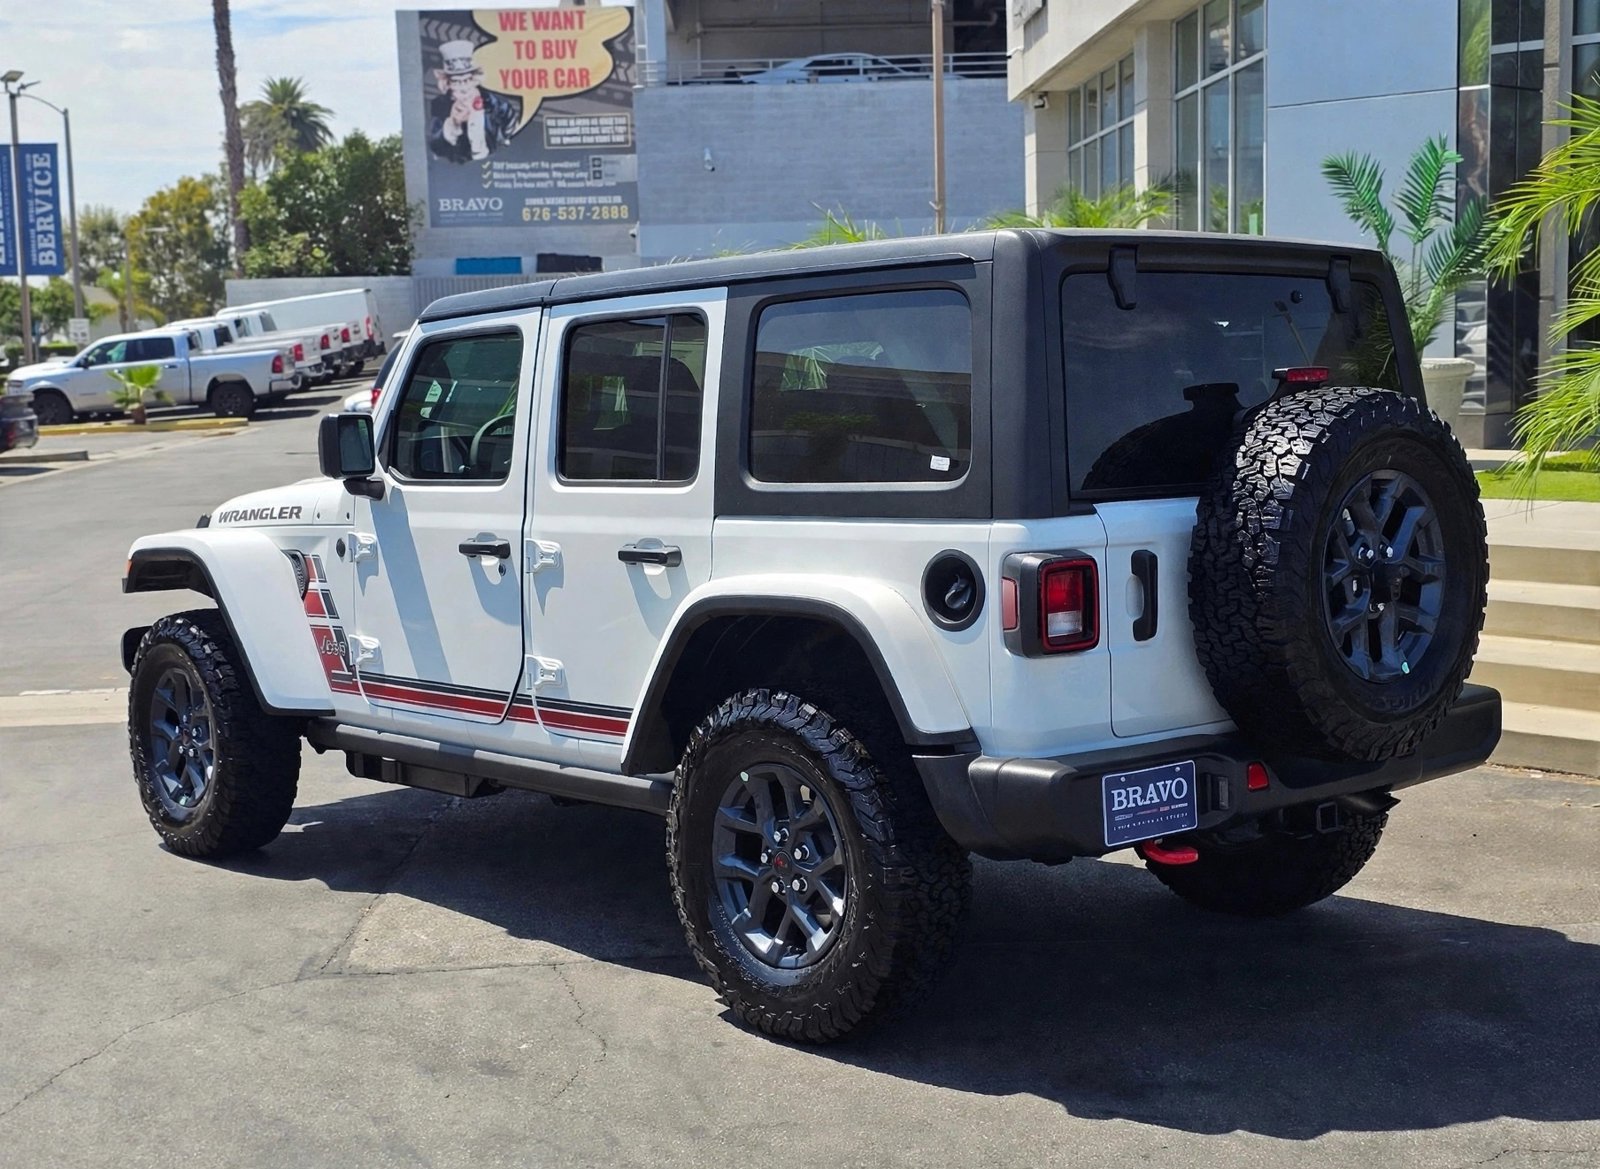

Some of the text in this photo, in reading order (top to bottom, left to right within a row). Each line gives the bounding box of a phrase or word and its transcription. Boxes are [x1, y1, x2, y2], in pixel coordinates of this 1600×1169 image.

[498, 9, 586, 31] WE WANT
[513, 39, 578, 61] TO BUY
[499, 67, 591, 90] YOUR CAR
[438, 196, 504, 212] BRAVO
[218, 505, 303, 524] WRANGLER
[1110, 777, 1188, 812] BRAVO
